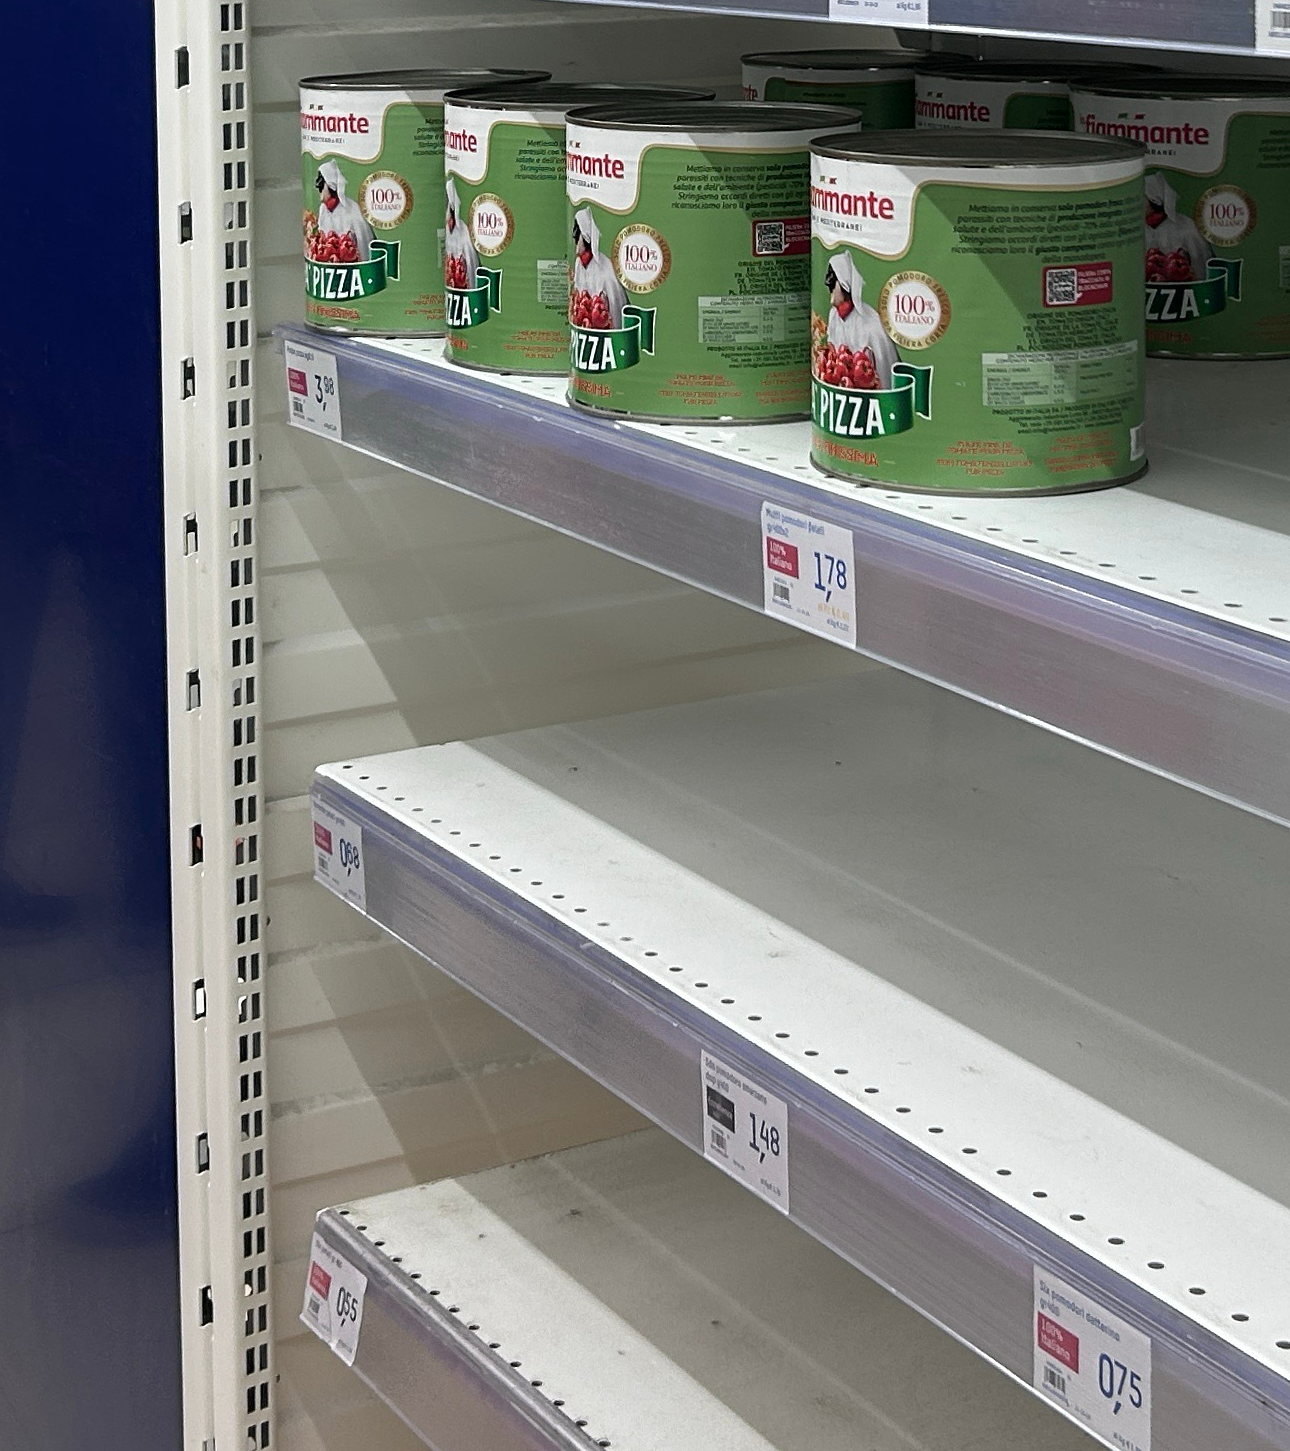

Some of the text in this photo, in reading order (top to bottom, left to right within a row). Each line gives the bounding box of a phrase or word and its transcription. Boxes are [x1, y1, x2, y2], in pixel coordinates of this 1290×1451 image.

[371, 188, 402, 204] 100%
[478, 212, 504, 229] 100%
[1210, 204, 1245, 220] 100%
[624, 245, 658, 263] 100%
[625, 263, 657, 272] ITALIANO
[312, 269, 364, 299] PIZZA
[894, 294, 935, 315] 100%
[895, 315, 934, 325] ITALIANO
[820, 390, 885, 436] PIZZA
[814, 551, 847, 602] 1,78
[749, 1112, 780, 1164] 1,48
[1098, 1352, 1142, 1415] 0,75
